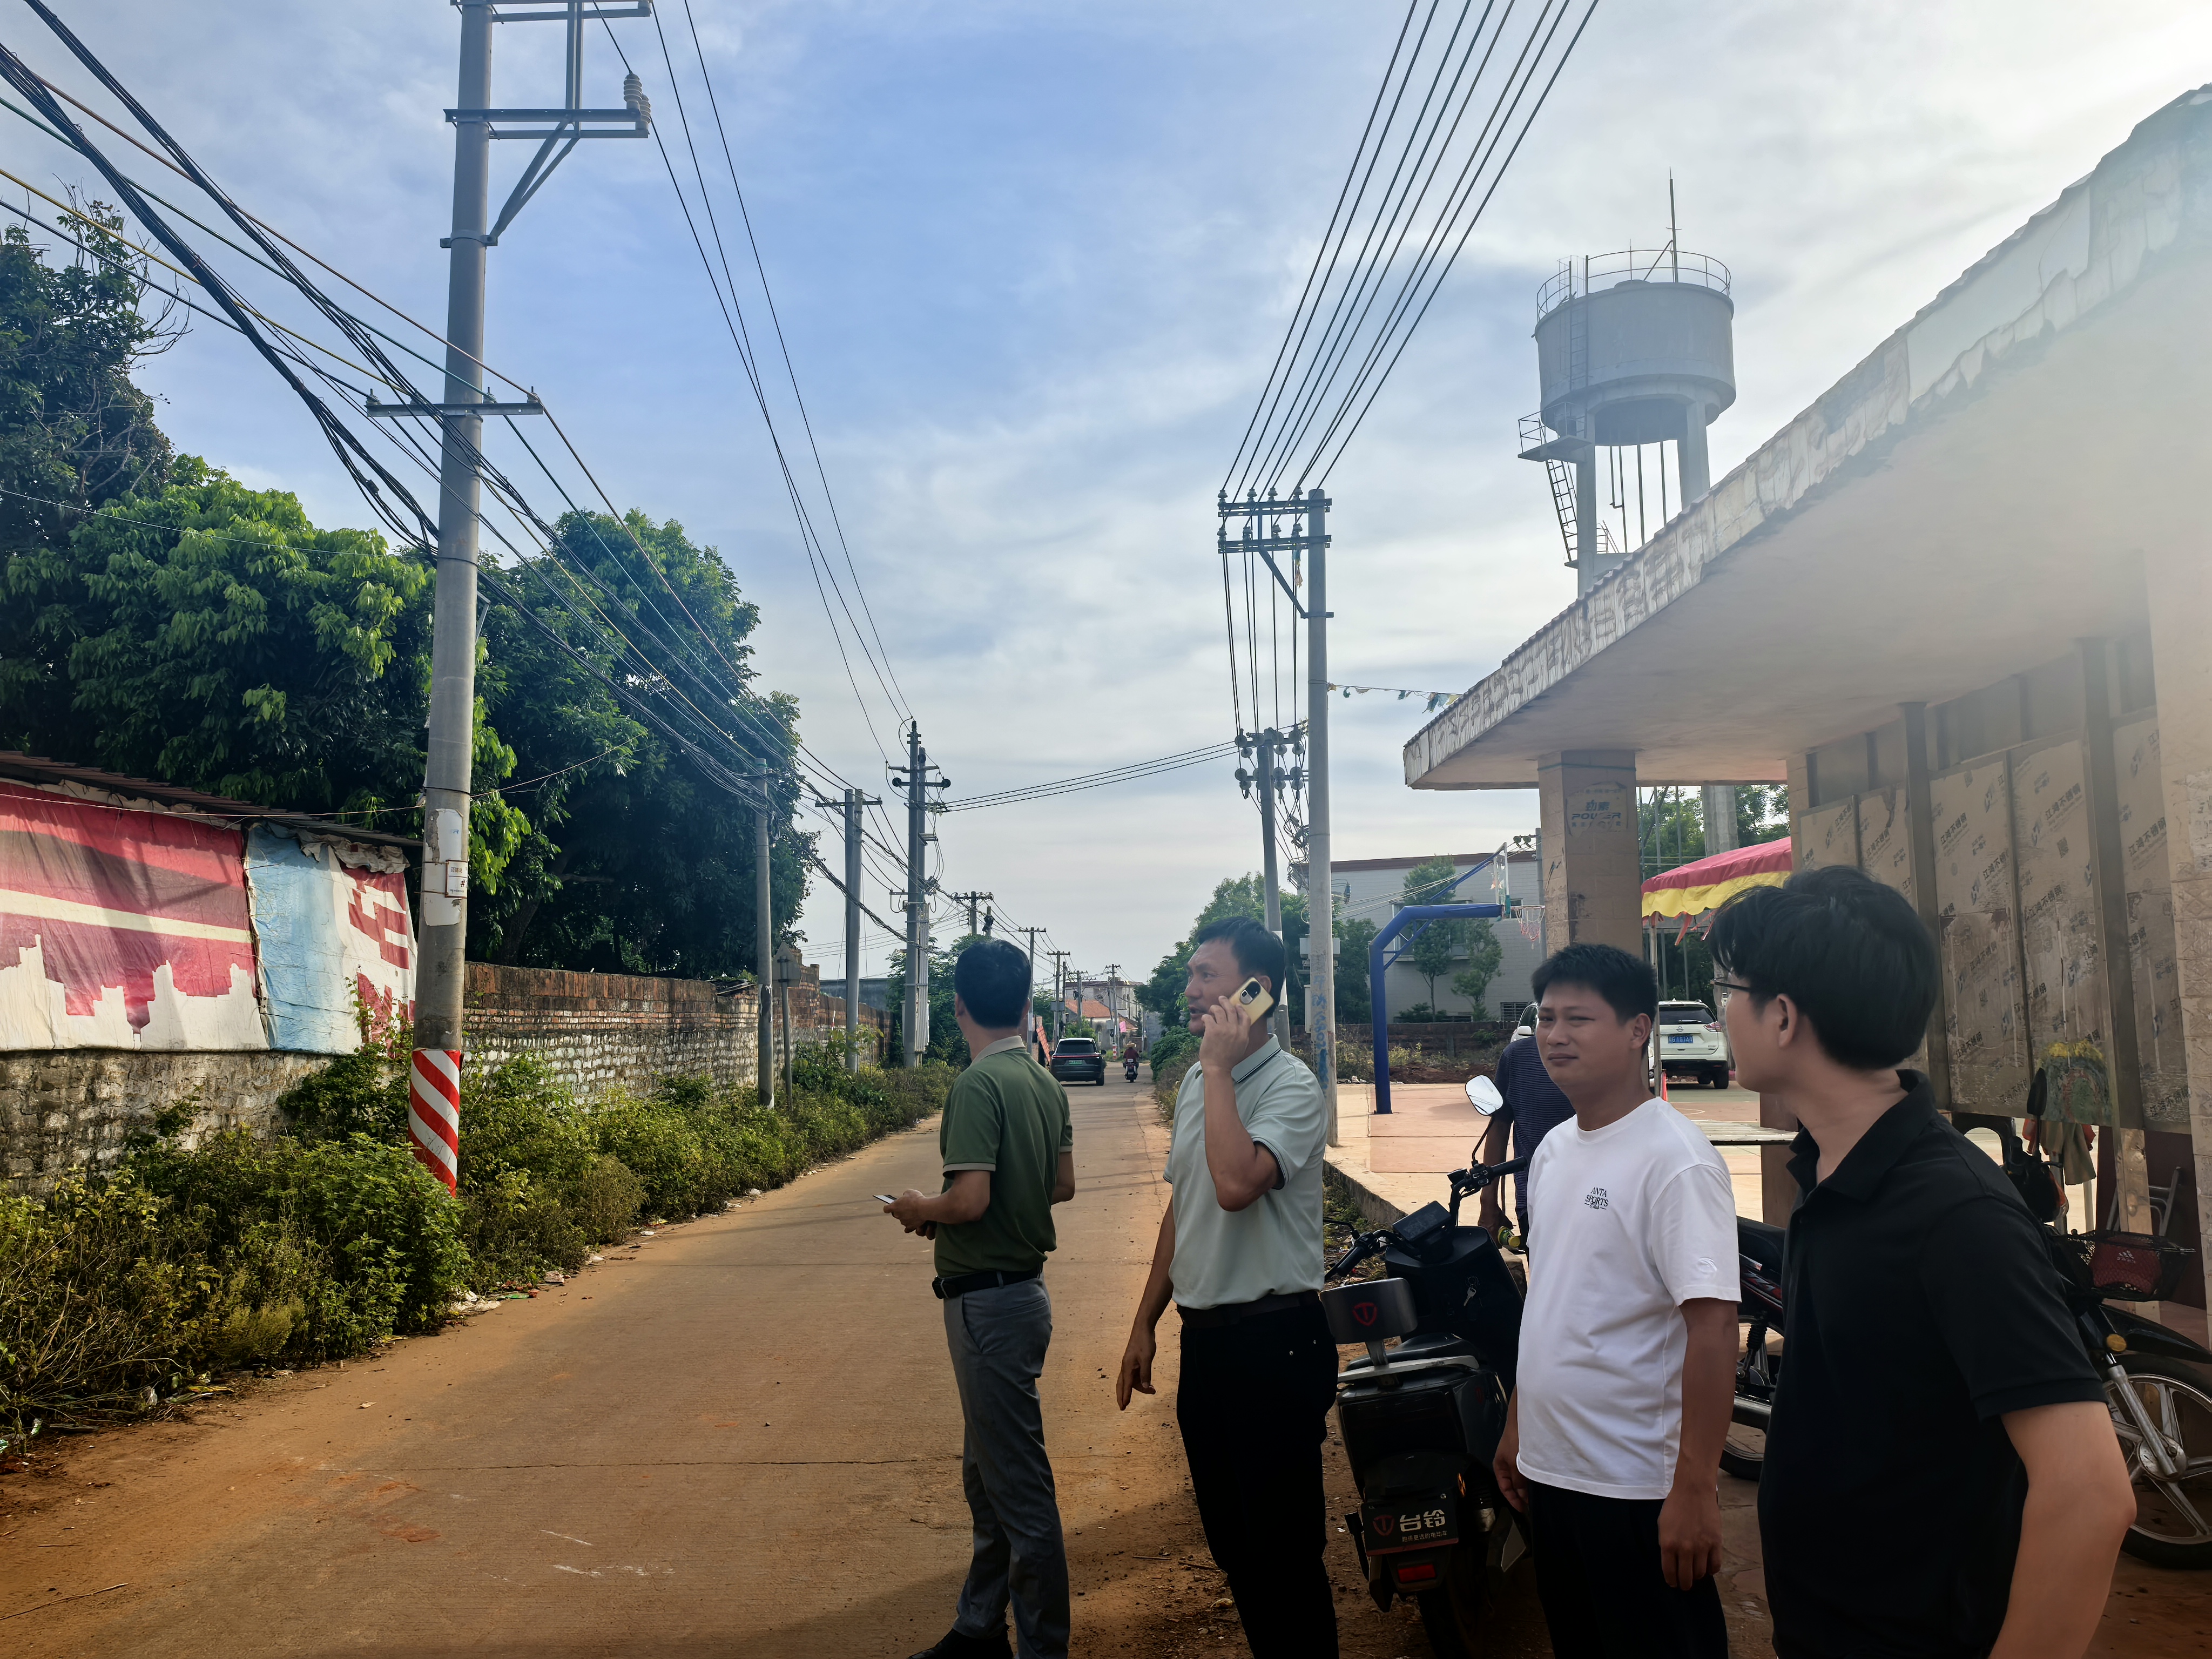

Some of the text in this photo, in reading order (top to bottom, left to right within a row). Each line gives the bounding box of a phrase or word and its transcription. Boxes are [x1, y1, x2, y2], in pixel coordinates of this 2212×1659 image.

[1590, 1187, 1607, 1197] ANTA
[1585, 1195, 1609, 1207] SPORTS
[1399, 1509, 1446, 1532] 台铃
